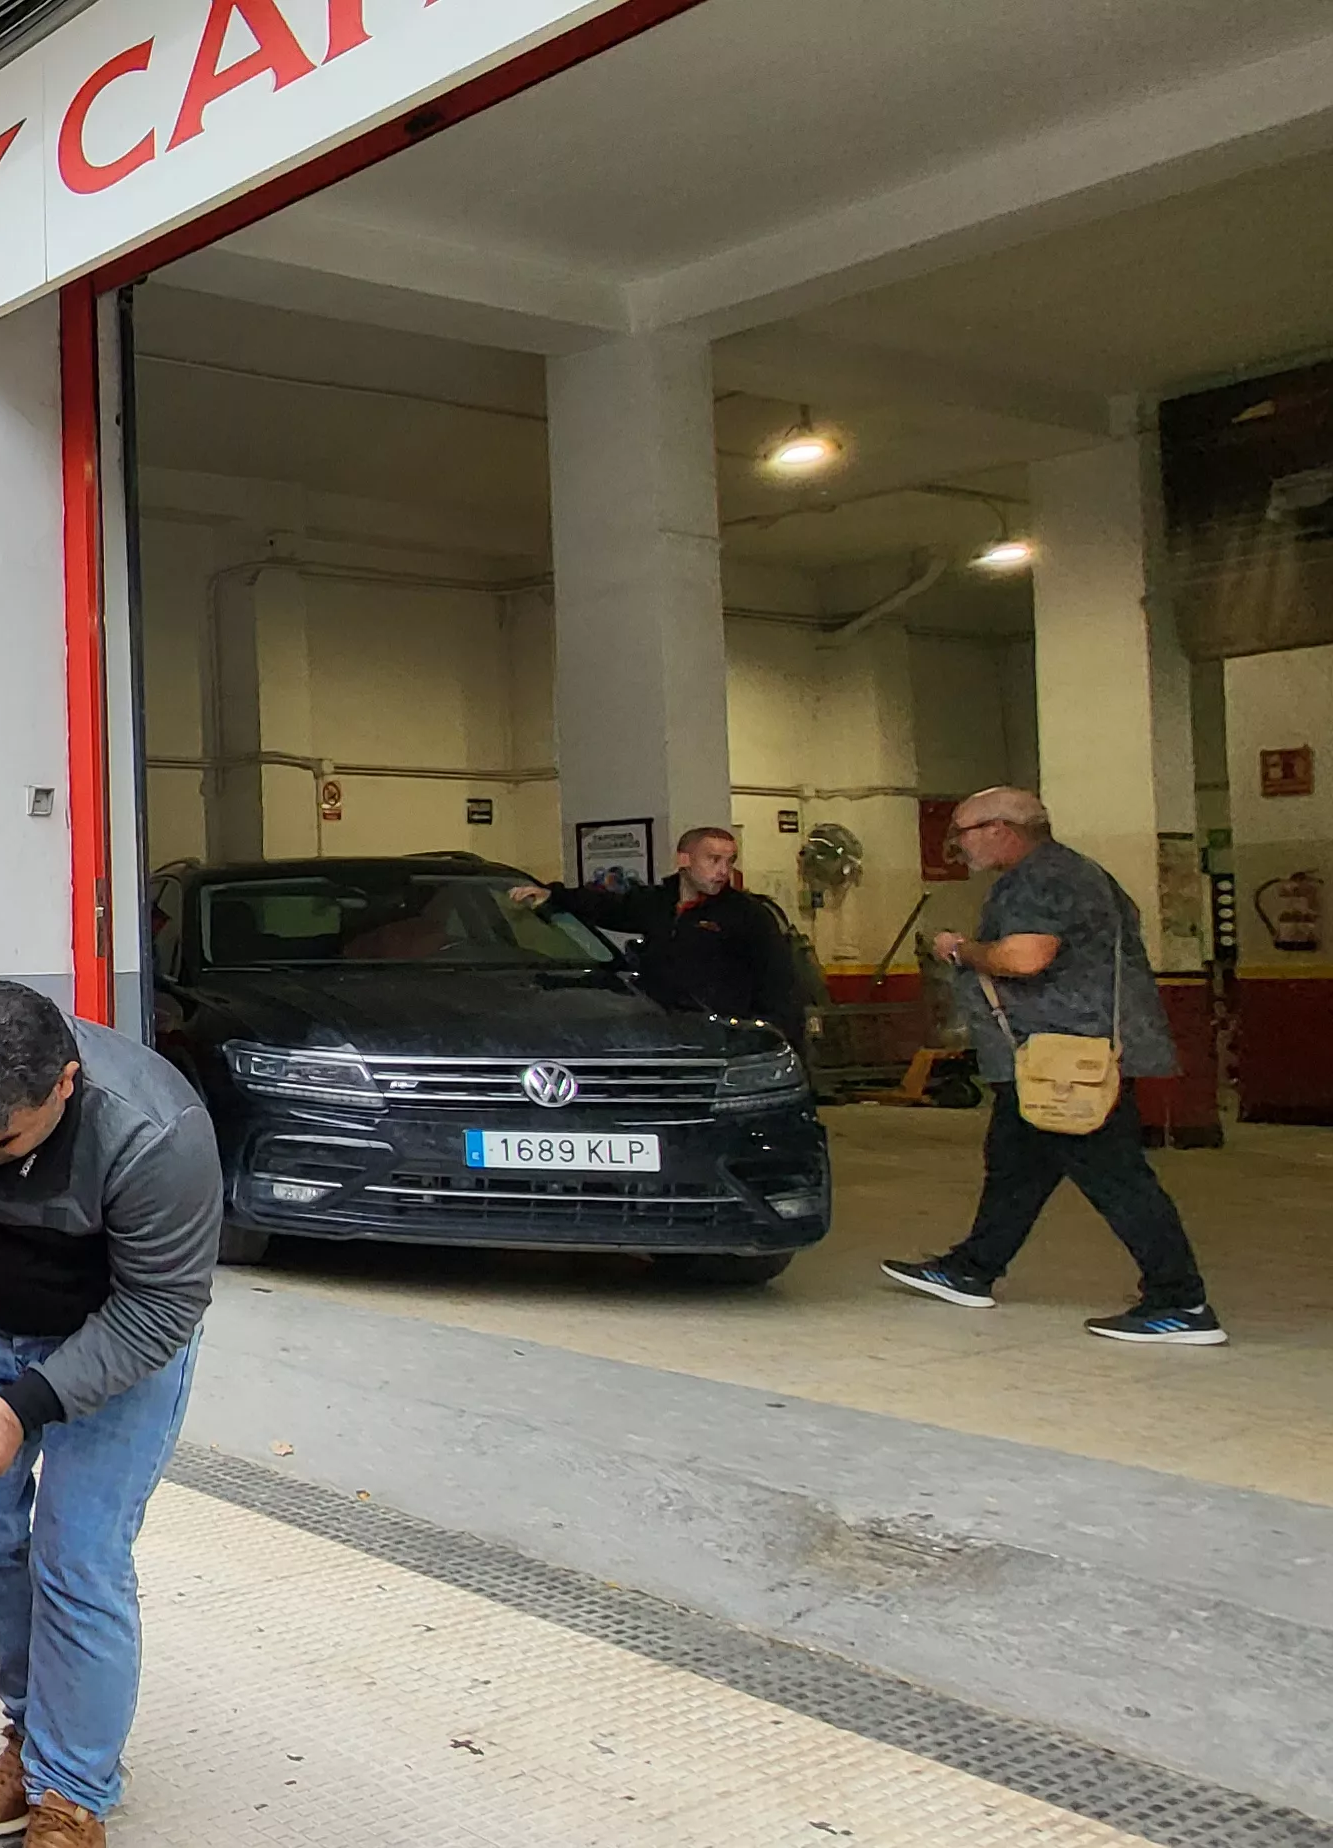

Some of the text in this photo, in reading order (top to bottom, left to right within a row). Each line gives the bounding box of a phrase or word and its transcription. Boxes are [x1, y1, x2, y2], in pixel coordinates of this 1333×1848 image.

[57, 0, 374, 195] CA
[500, 1138, 644, 1164] 1689 KLP
